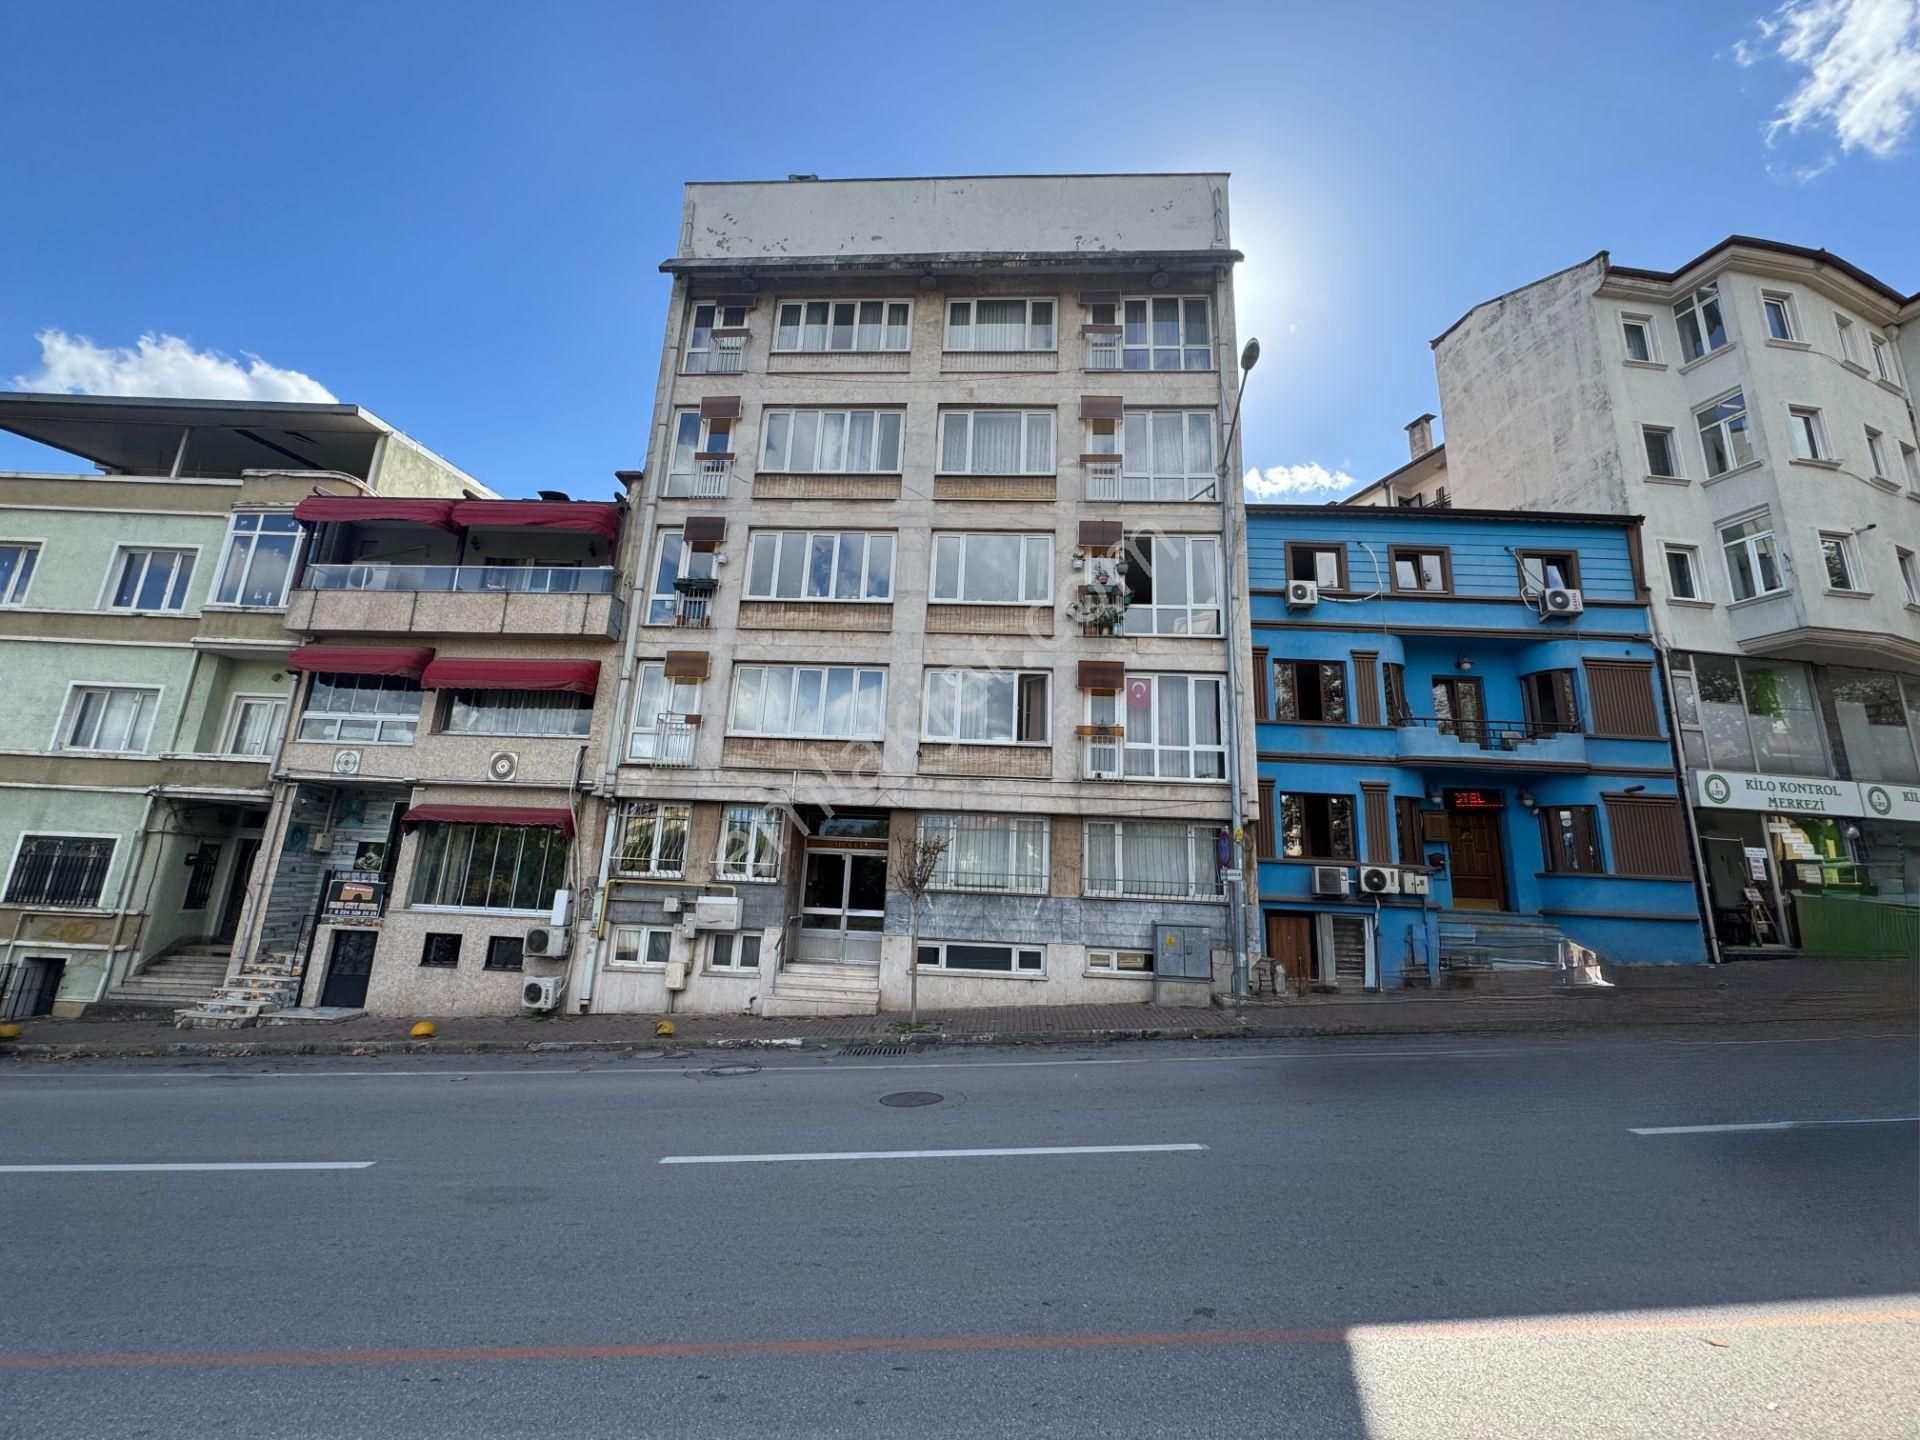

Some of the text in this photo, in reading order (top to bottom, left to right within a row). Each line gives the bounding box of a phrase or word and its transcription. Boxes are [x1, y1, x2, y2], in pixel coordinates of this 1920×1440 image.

[1744, 778, 1842, 796] KİLO KONTROL
[1767, 797, 1826, 811] MERKEZİ
